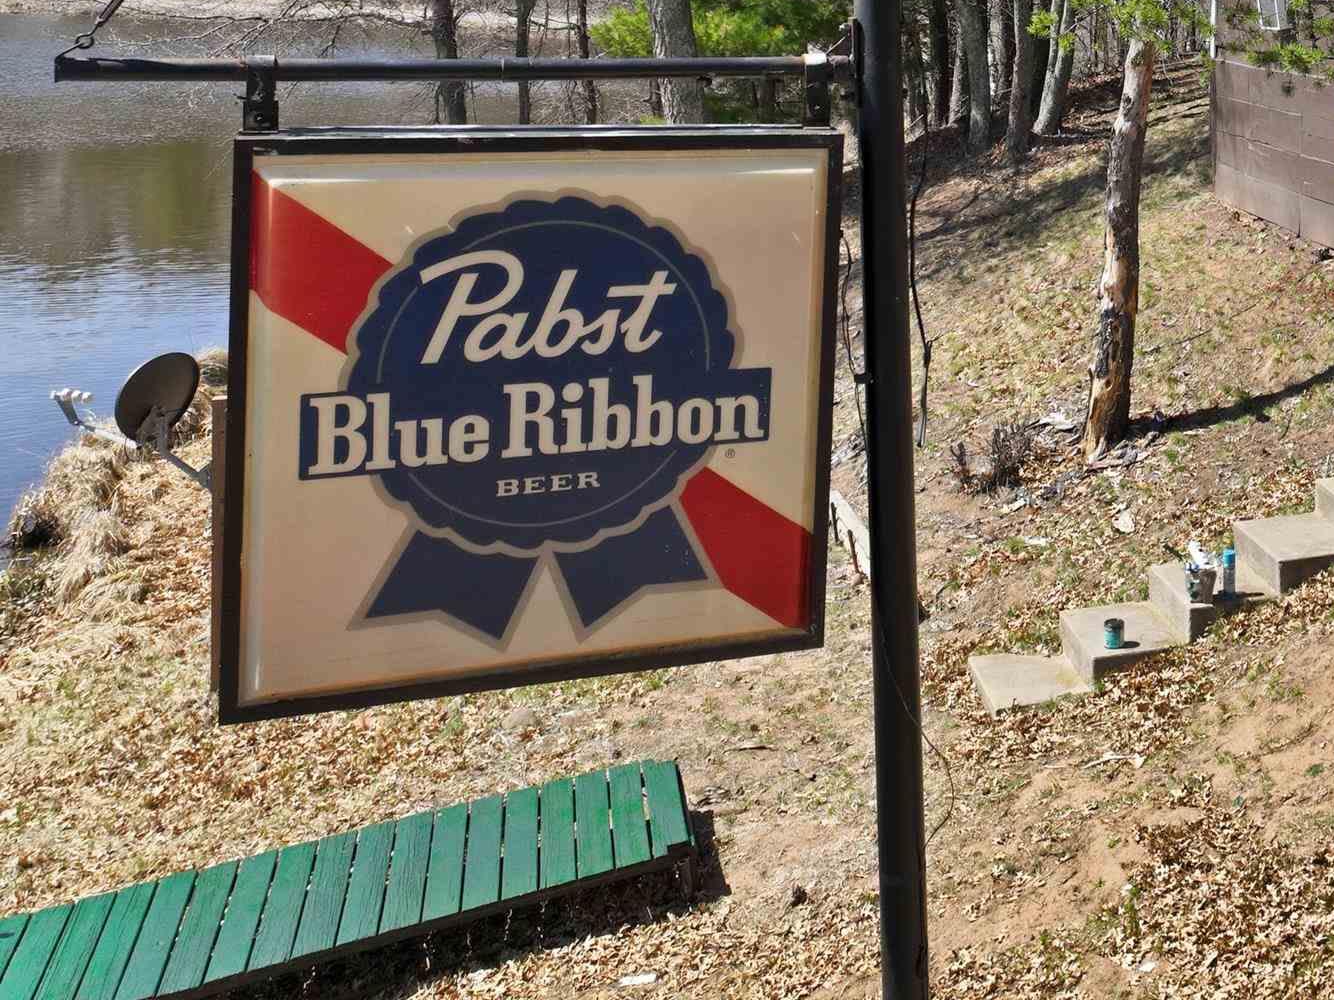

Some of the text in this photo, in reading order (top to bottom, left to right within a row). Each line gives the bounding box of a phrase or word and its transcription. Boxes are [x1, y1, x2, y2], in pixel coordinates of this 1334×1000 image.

[419, 249, 677, 364] Pabst
[306, 374, 765, 477] Blue Ribbon
[495, 471, 601, 498] BEER
